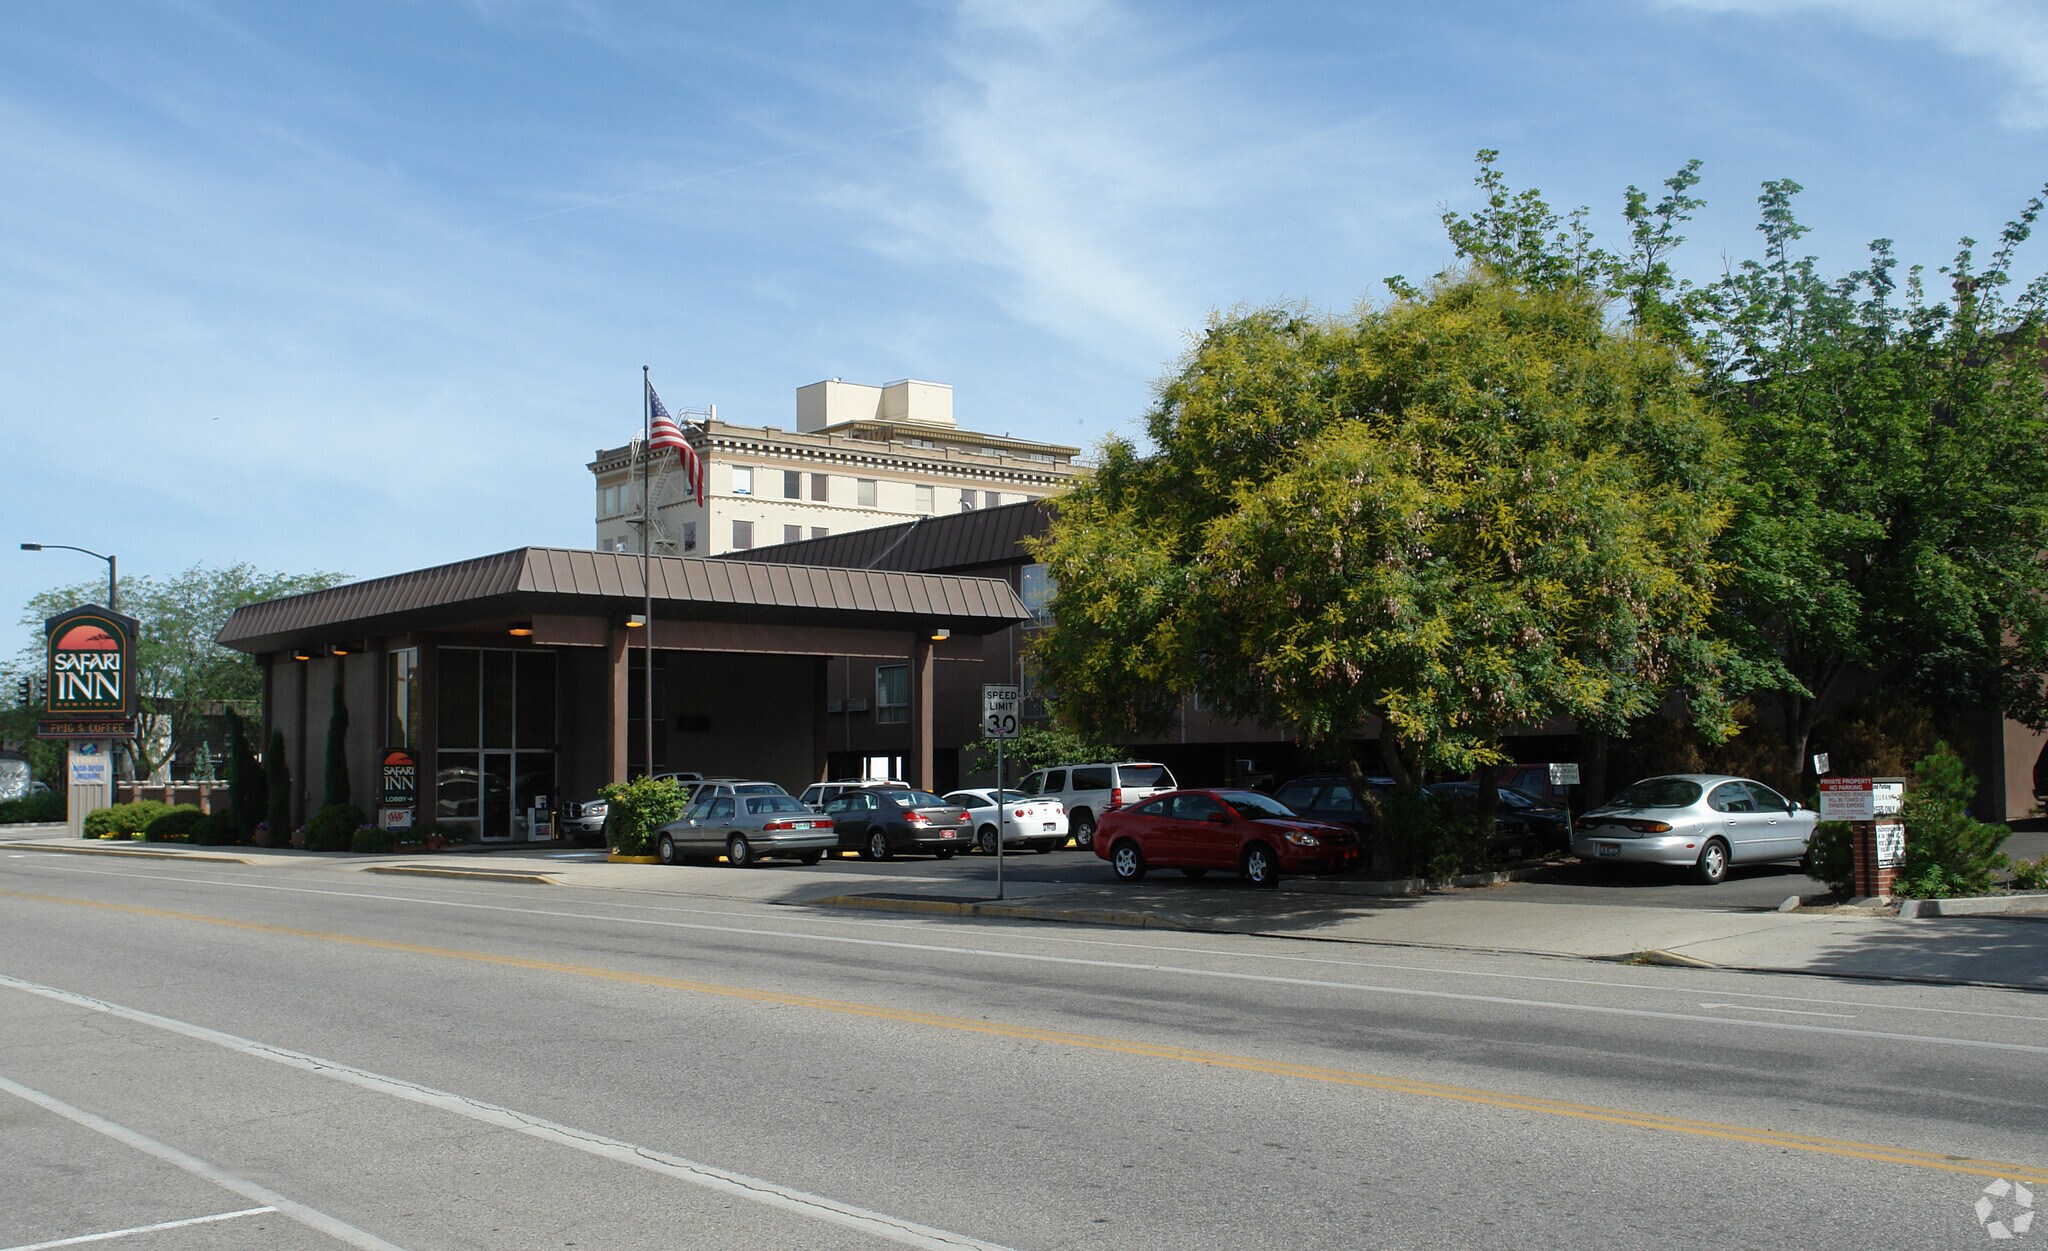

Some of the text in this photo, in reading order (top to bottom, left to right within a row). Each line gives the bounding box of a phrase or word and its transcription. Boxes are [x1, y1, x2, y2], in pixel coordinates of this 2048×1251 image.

[54, 653, 120, 676] SAFARI
[55, 671, 120, 700] INN
[986, 691, 1017, 700] SPEED
[990, 702, 1013, 711] LIMIT
[987, 714, 1016, 734] 30
[383, 766, 415, 778] SAFARI
[384, 776, 414, 790] INN
[388, 812, 402, 821] AAA
